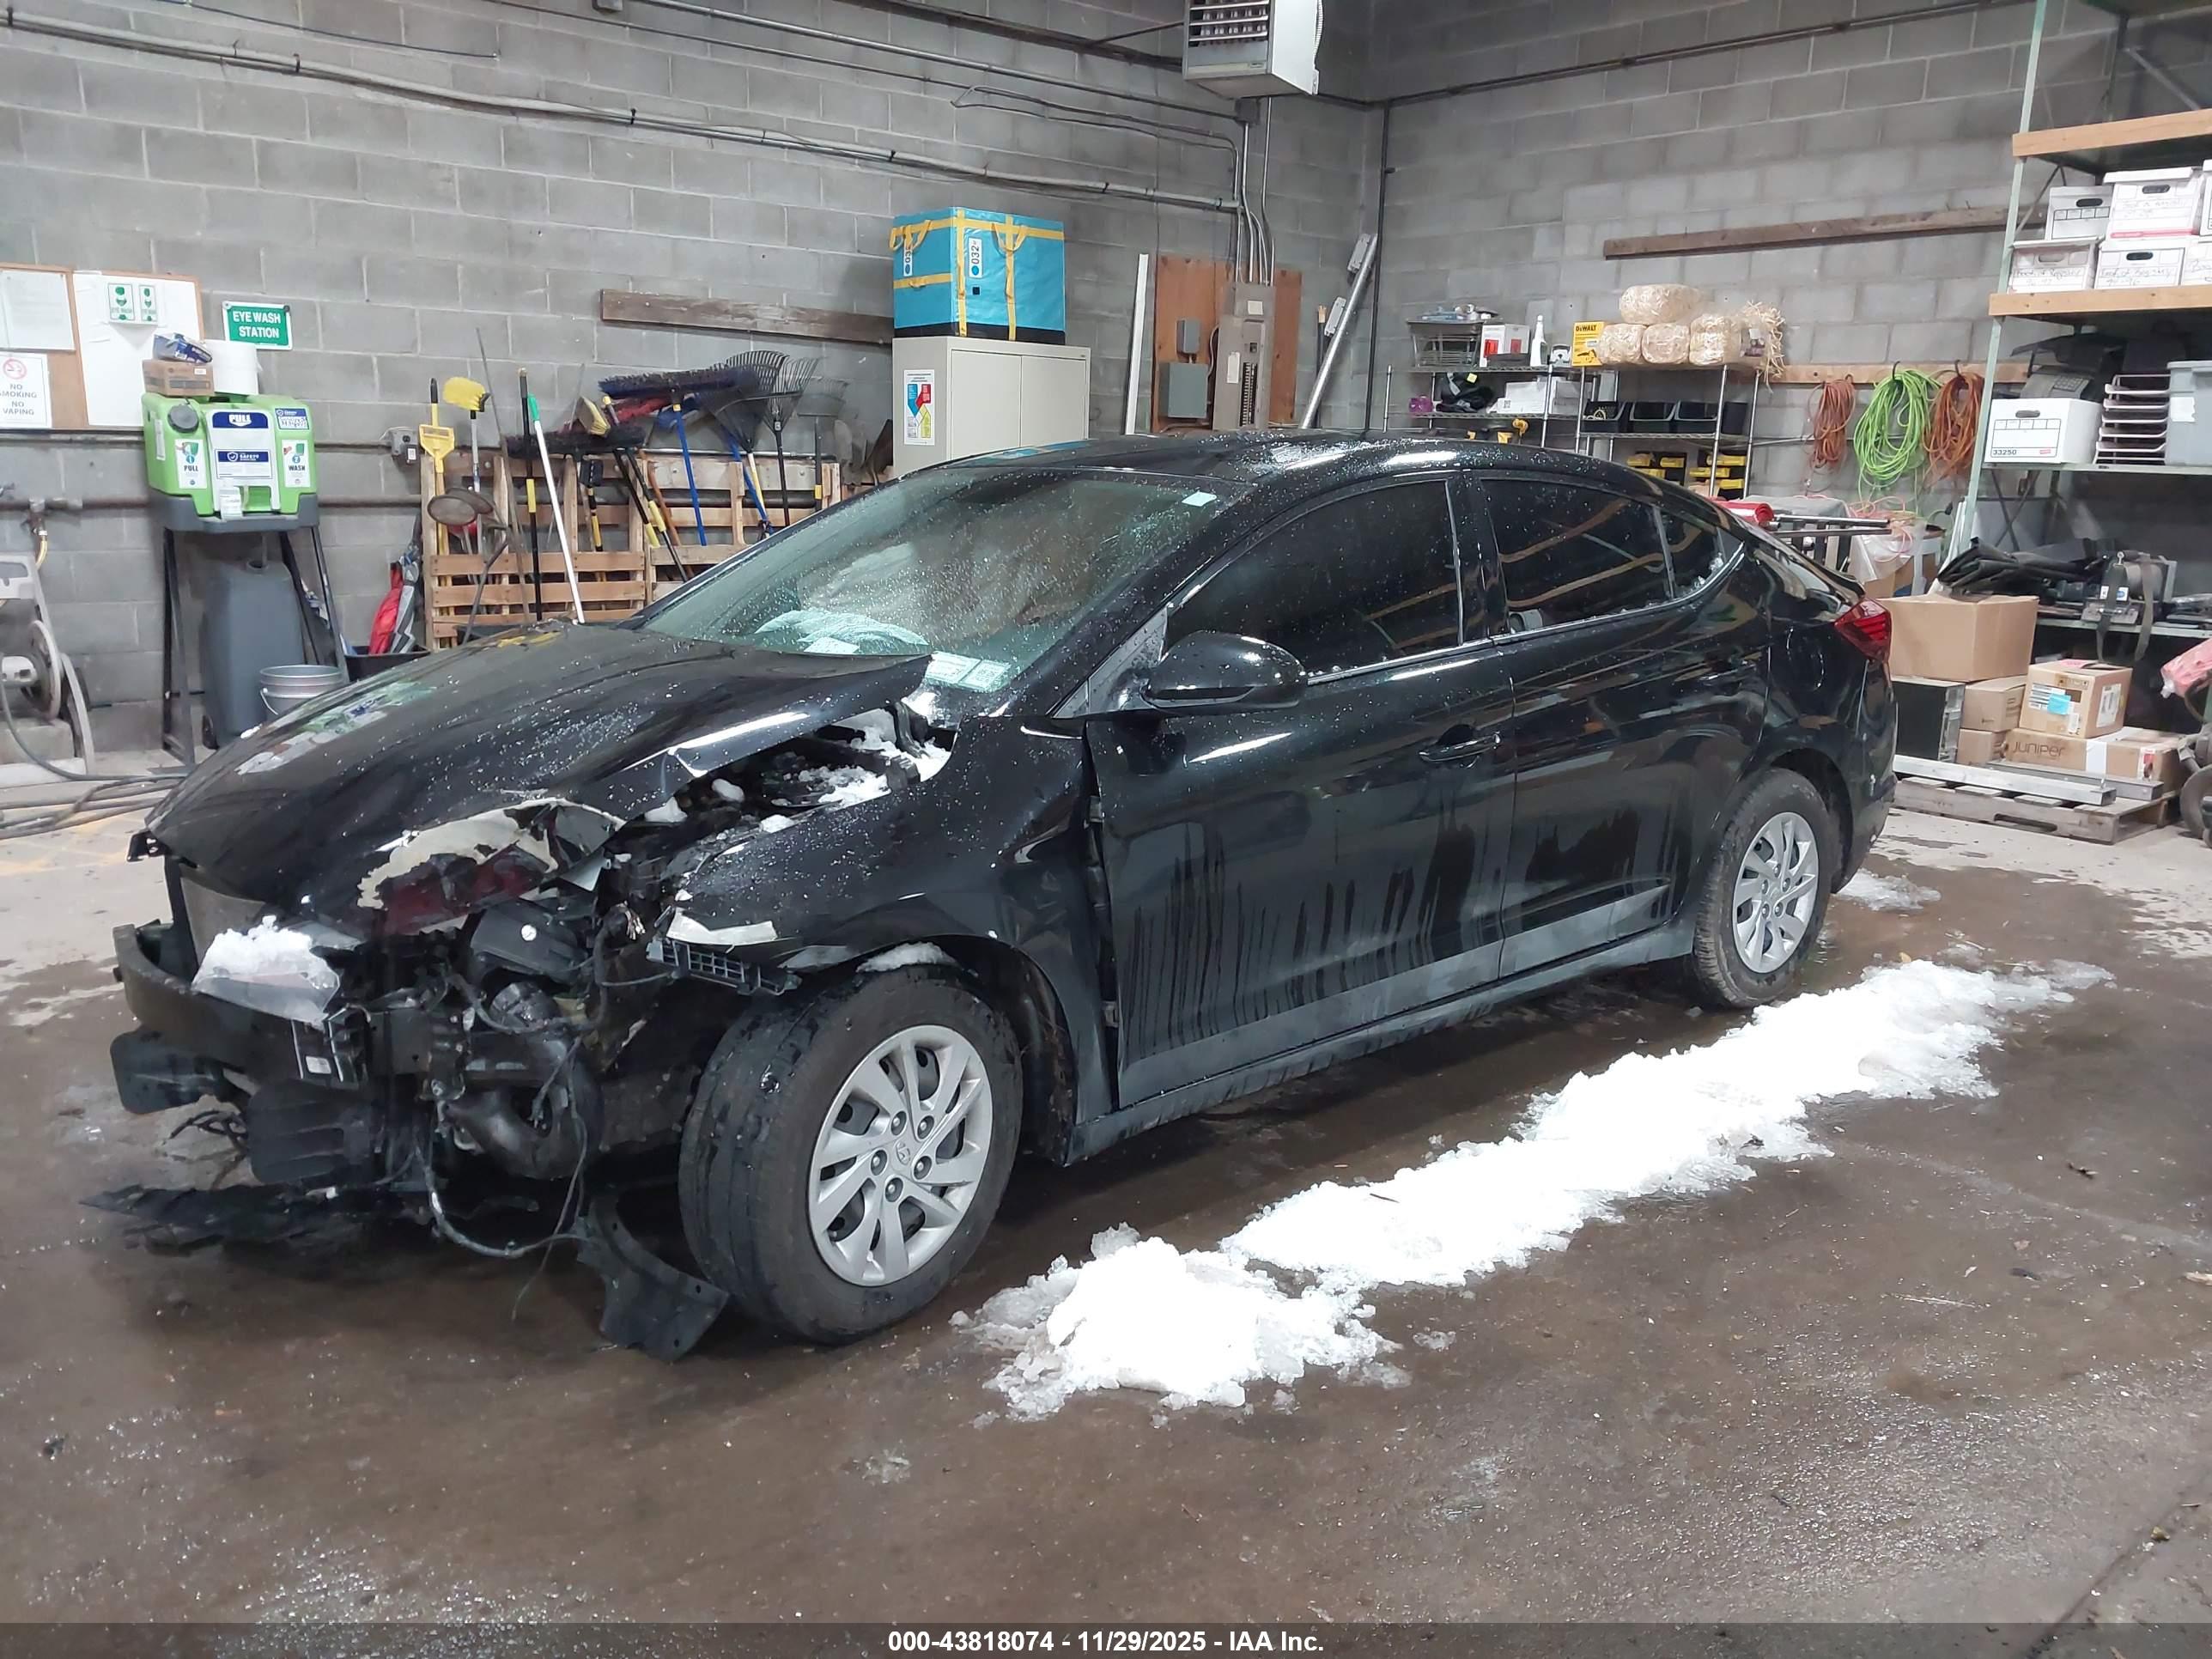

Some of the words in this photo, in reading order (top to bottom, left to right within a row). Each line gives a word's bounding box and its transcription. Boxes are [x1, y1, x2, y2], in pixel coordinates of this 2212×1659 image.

[233, 311, 252, 323] EYE
[252, 312, 281, 324] WASH
[239, 326, 280, 338] STATION
[228, 414, 251, 423] PULL
